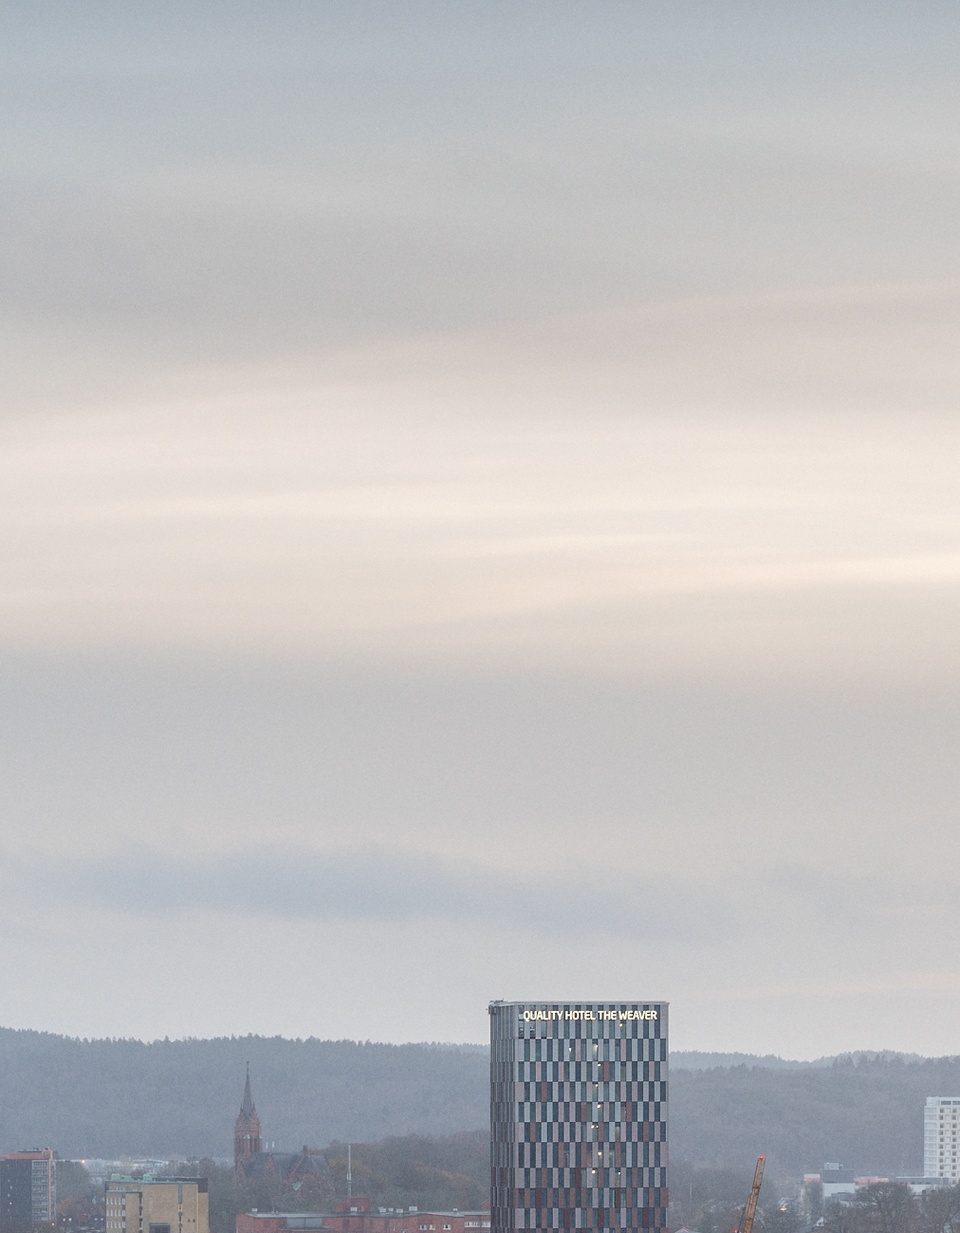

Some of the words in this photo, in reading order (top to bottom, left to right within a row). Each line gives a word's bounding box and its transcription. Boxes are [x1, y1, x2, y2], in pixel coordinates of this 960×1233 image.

[523, 1010, 563, 1021] QUALITY
[565, 1010, 595, 1021] HOTEL
[598, 1010, 616, 1021] THE
[618, 1010, 658, 1021] WEAVER
